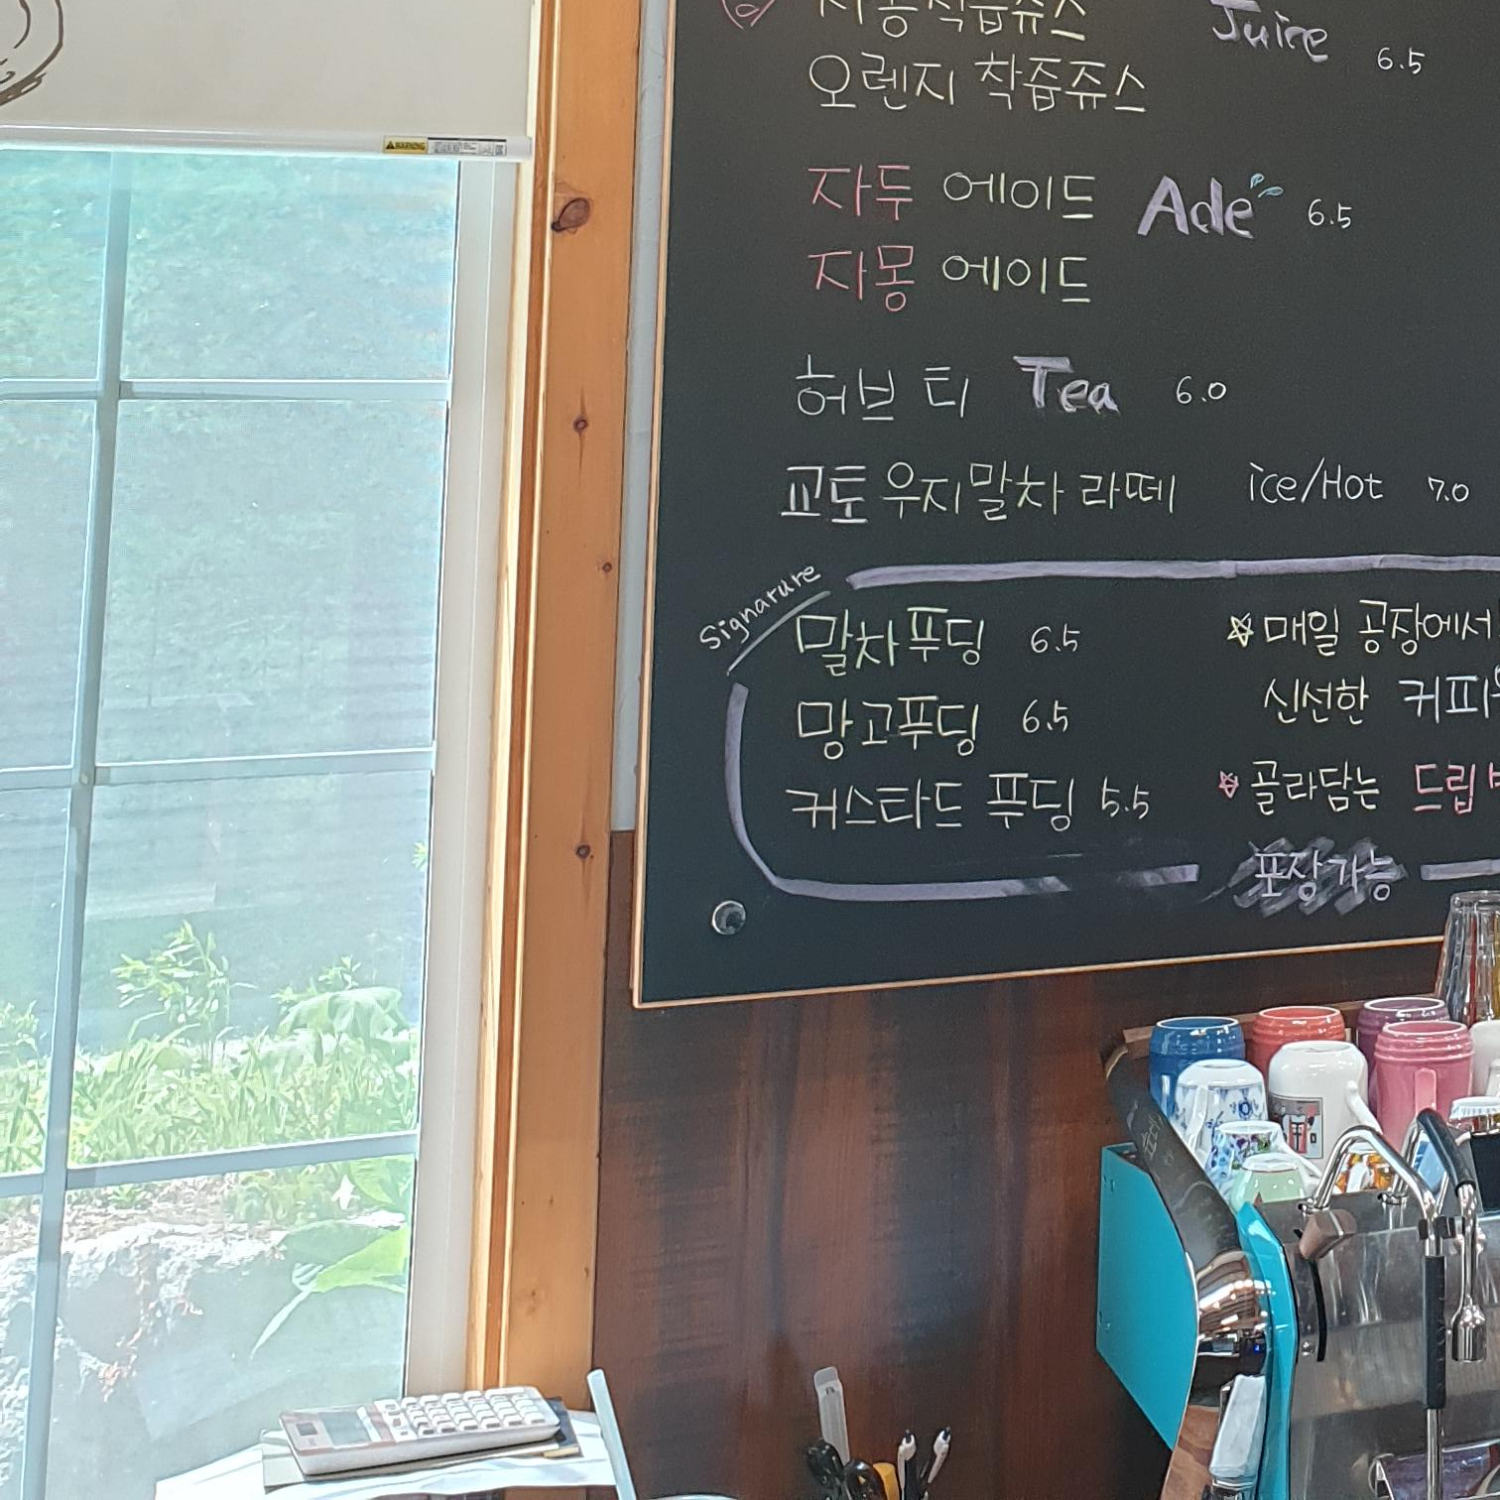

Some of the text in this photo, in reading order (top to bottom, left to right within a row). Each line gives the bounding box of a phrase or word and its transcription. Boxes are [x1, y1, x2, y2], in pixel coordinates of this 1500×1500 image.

[808, 51, 1146, 113] 오렌지 착즙쥬스
[1377, 46, 1426, 75] 6.5
[807, 164, 1096, 221] 자두 에이드
[1136, 175, 1353, 240] Ade 6.5
[807, 245, 1091, 312] 자몽 에이드
[795, 354, 969, 421] 허브 티
[1012, 355, 1227, 415] Tea 6.0
[1079, 471, 1176, 514] 라떼
[1427, 476, 1470, 503] 7.0
[796, 606, 1081, 677] 말차푸딩 6.5
[1263, 607, 1339, 657] 매일
[797, 695, 1069, 760] 망고푸딩 6.5
[1263, 675, 1370, 725] 신선한
[785, 772, 1150, 832] 커스타드 푸딩 5.5
[1254, 848, 1394, 902] 포장가능
